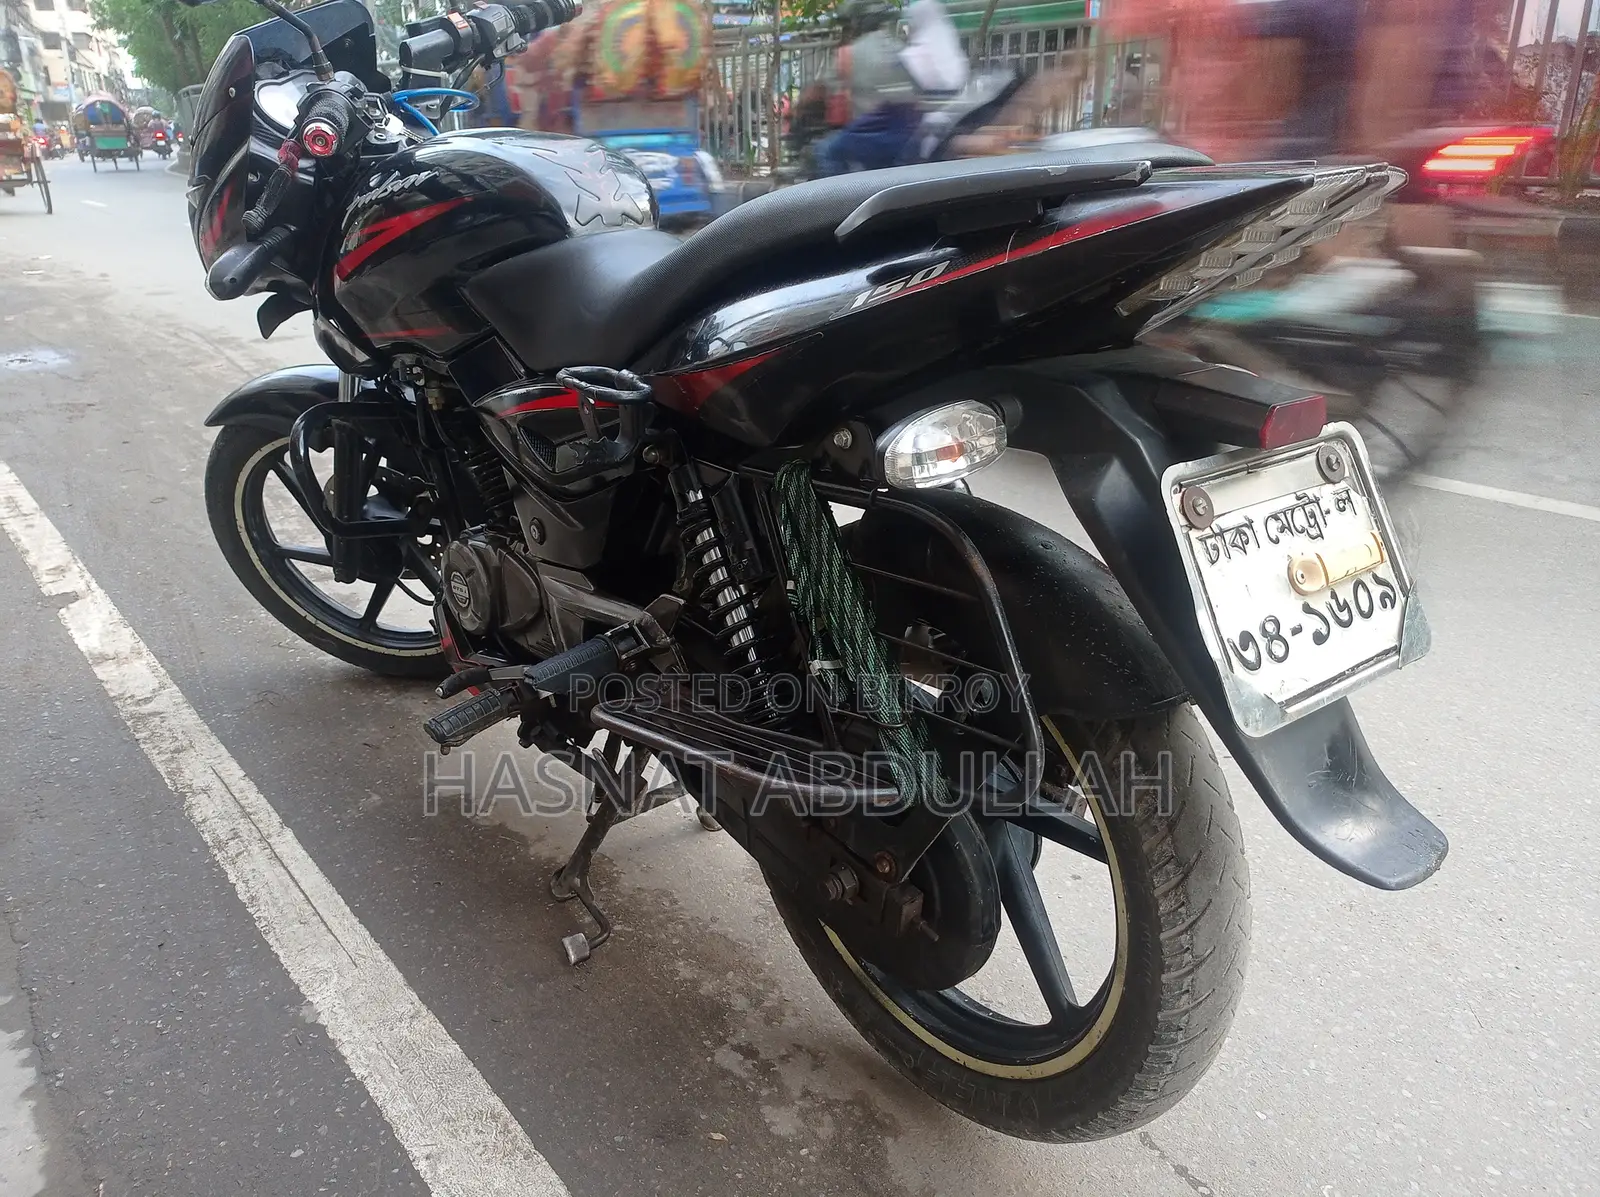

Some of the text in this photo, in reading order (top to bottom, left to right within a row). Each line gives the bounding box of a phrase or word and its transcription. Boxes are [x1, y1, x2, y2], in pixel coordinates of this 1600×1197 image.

[850, 260, 951, 311] 150
[1197, 514, 1261, 567] ঢাকা
[1227, 571, 1397, 672] ৩৪-১৬০৯
